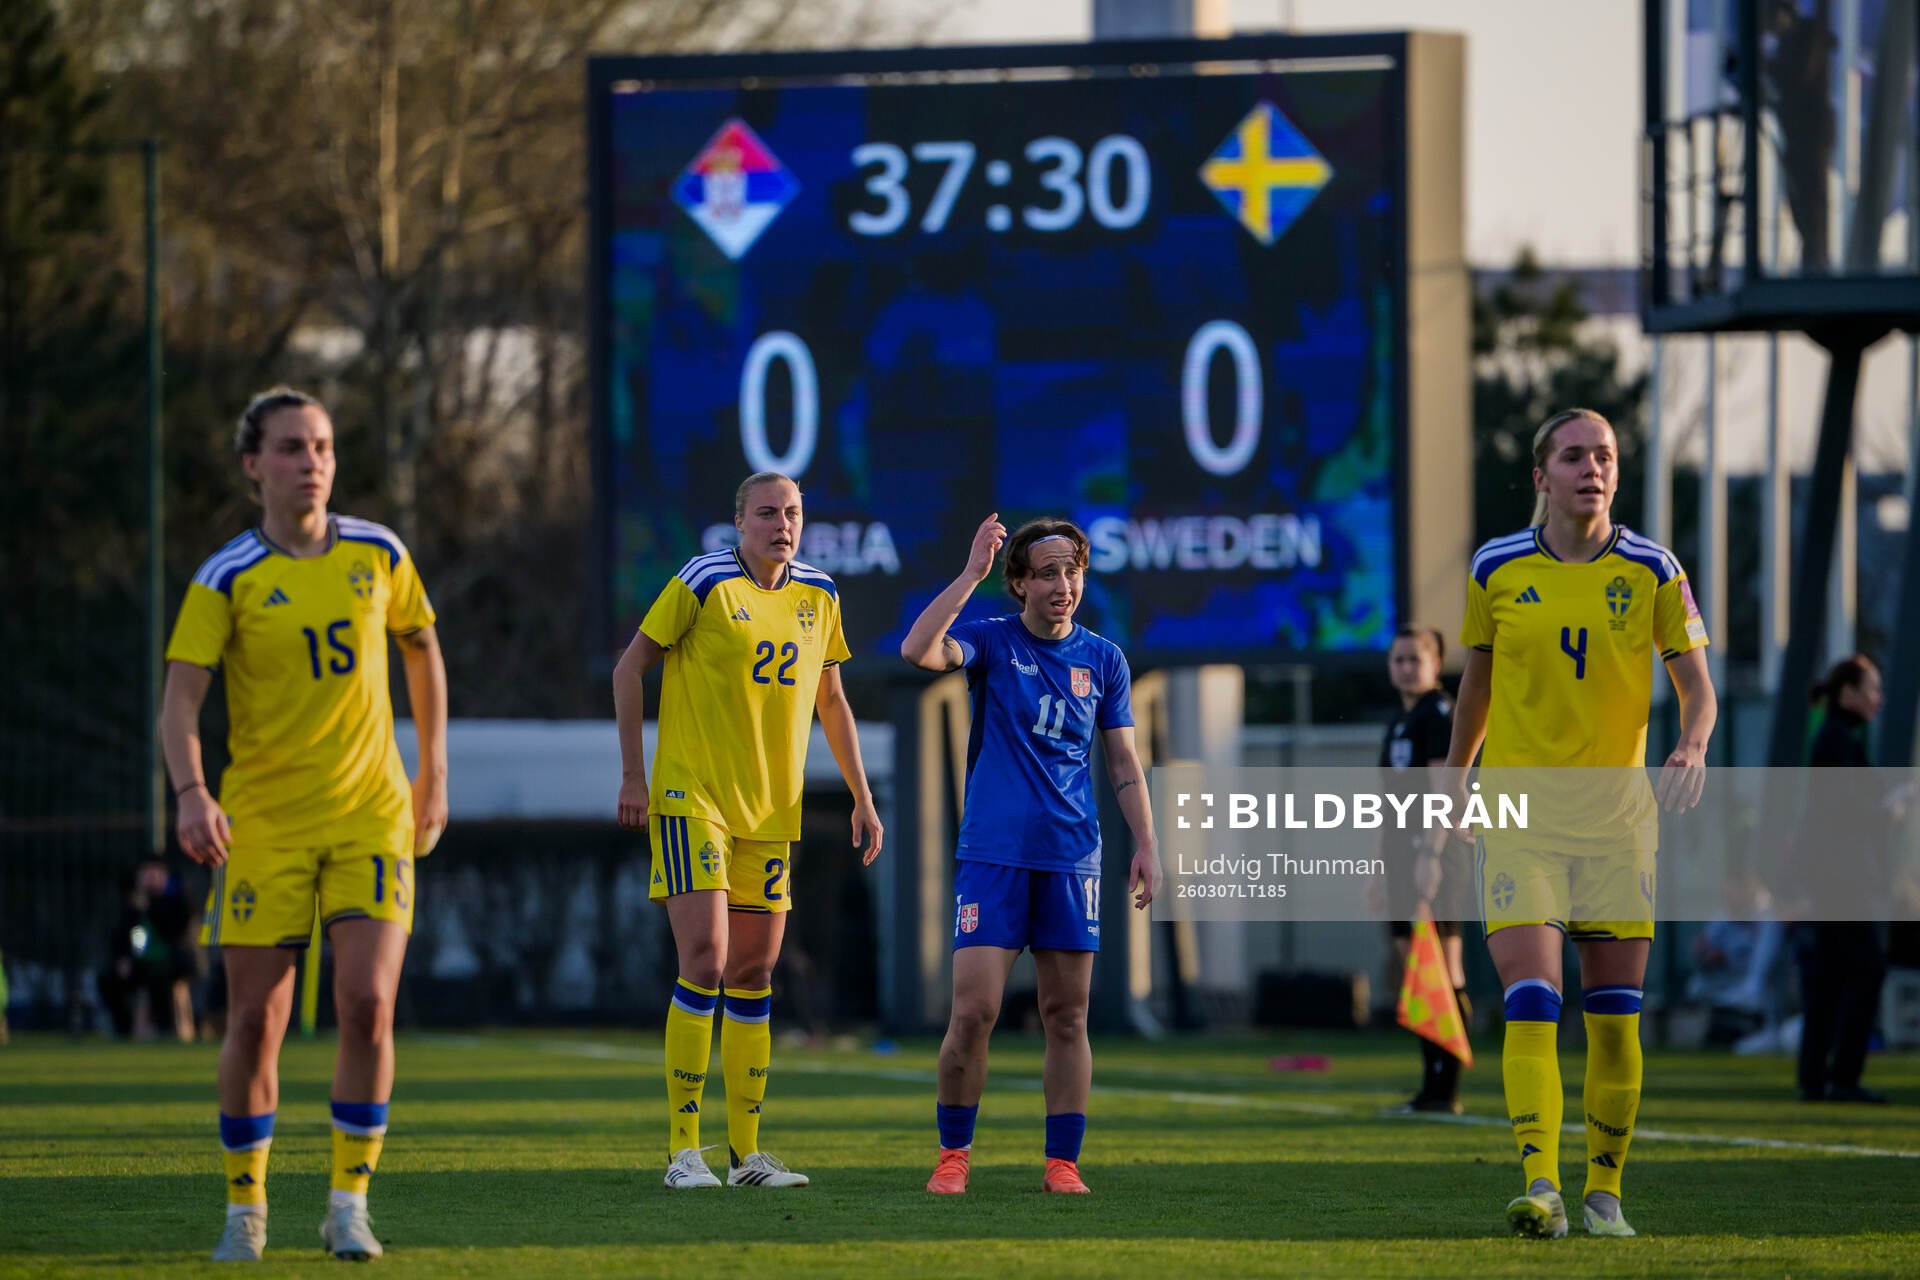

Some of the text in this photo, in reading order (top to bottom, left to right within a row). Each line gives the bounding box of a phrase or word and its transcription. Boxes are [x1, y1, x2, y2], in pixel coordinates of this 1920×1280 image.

[848, 134, 1153, 236] 37:30
[738, 330, 820, 479] 0
[1180, 318, 1264, 477] 0
[702, 520, 901, 576] SBIA
[1088, 514, 1322, 573] SWEDEN
[302, 620, 355, 680] 15
[752, 640, 799, 686] 22
[1560, 626, 1587, 680] 4
[1032, 694, 1066, 739] 11
[372, 854, 411, 911] 15
[763, 857, 790, 901] 2
